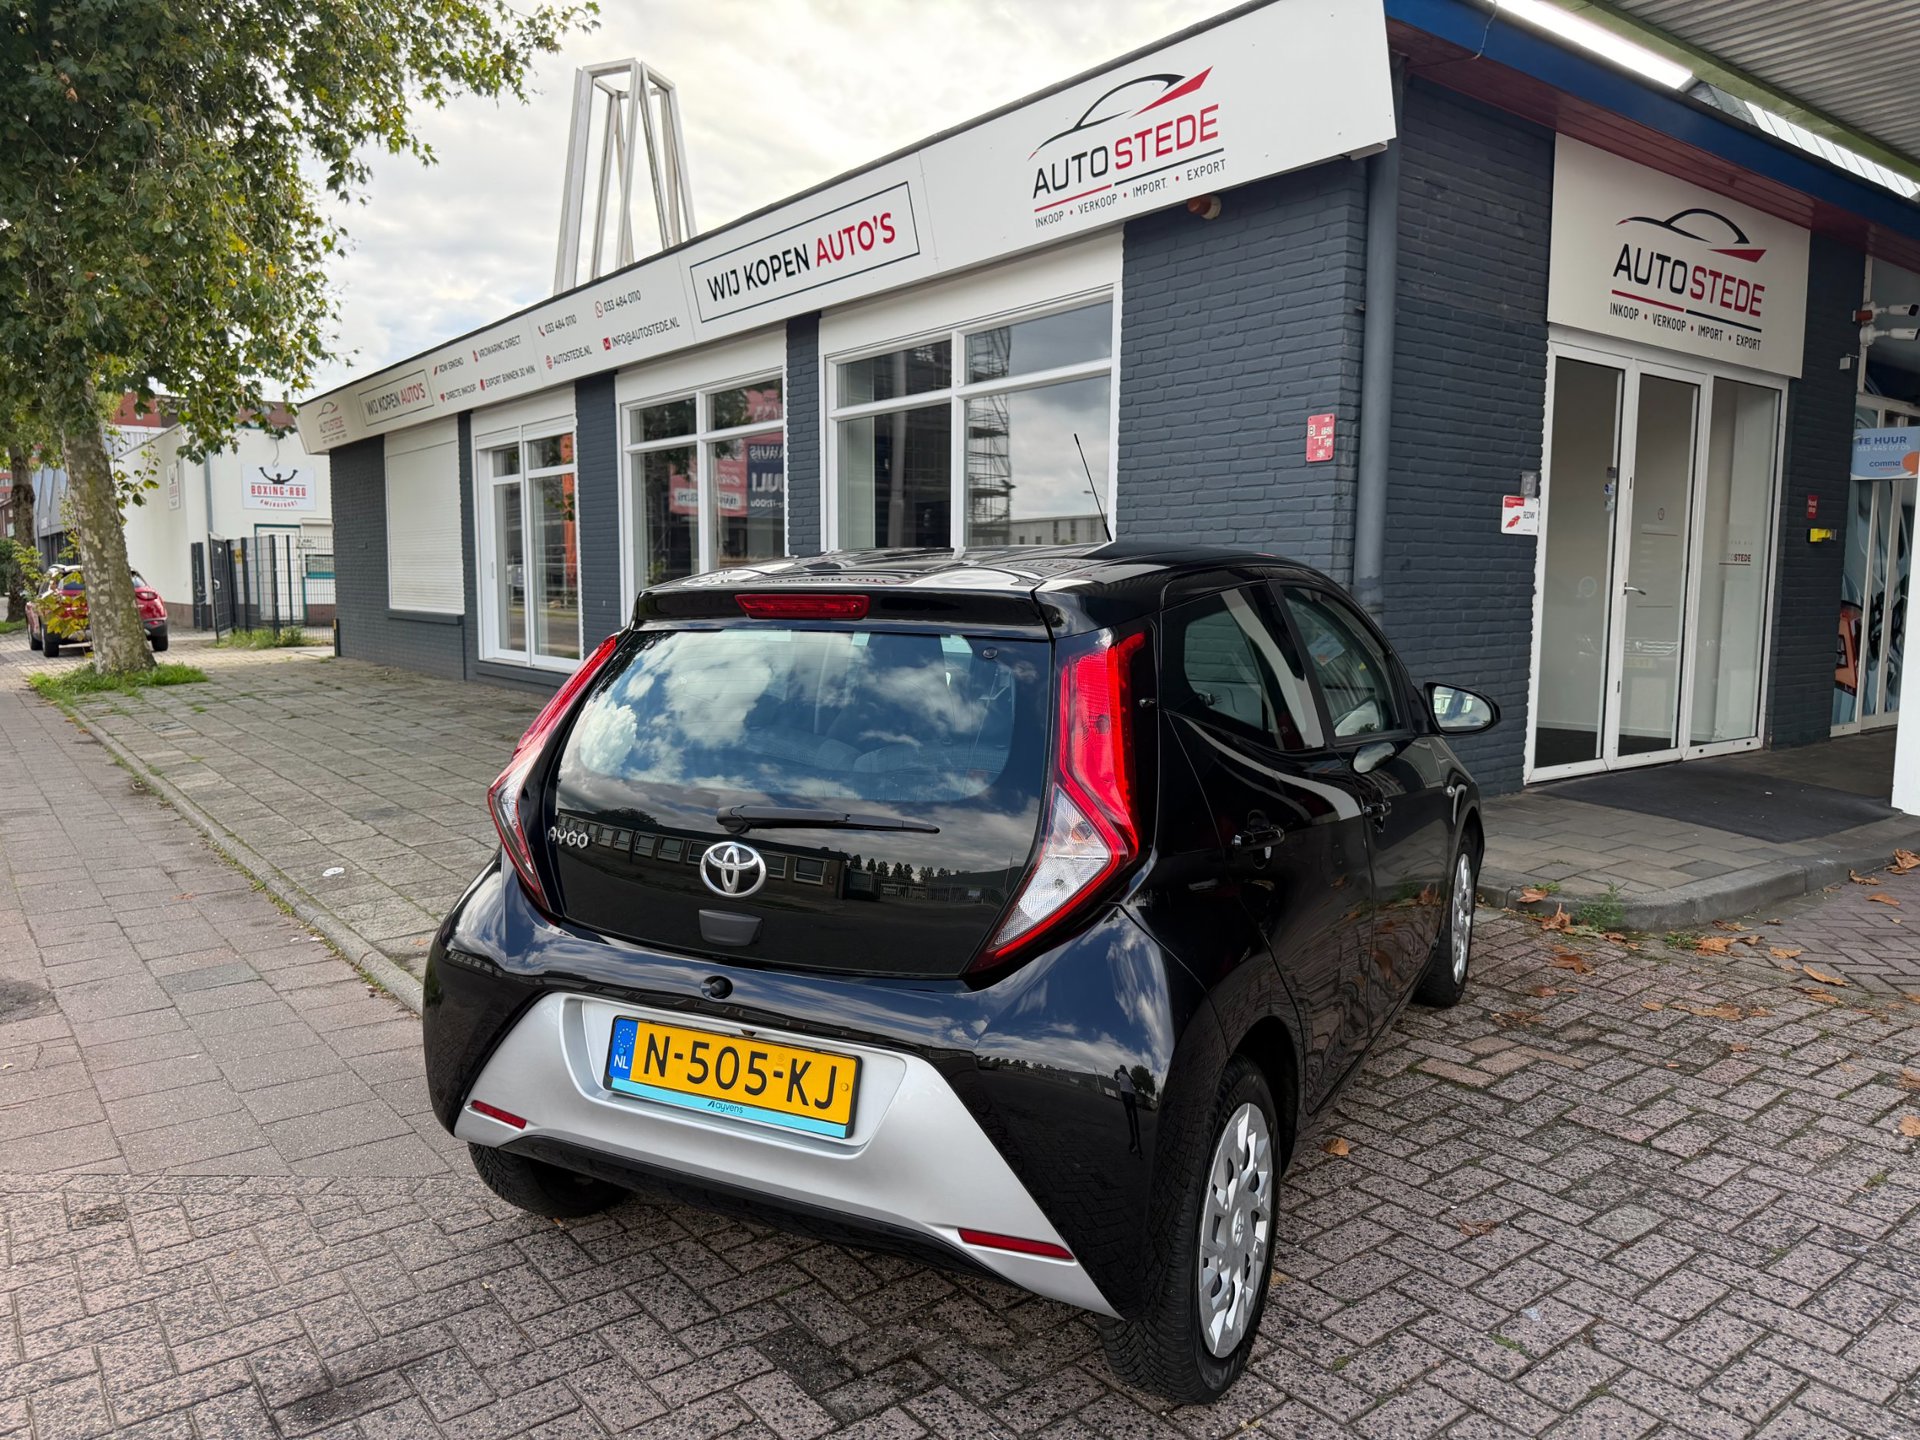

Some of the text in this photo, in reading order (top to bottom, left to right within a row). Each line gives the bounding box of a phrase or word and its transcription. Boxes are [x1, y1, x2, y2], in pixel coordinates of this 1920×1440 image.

[1035, 159, 1226, 228] INKOOP VERKOOP IMPORT EXPORT
[707, 212, 896, 302] WIJ KOPEN AUTO'S
[604, 290, 641, 312] 033 484 0110
[544, 322, 554, 334] 033
[555, 319, 566, 330] 484
[611, 317, 680, 347] INFO@AUTOSTEDE.NL
[1610, 302, 1762, 351] INKOOP VERKOOP IMPORT EXPORT
[553, 345, 592, 365] AUTOSTEDE.NL
[485, 374, 501, 388] EXPORT
[365, 383, 426, 416] WIJ KOPEN AUTO'S
[1858, 435, 1907, 446] TE HUUR
[547, 826, 589, 849] AYGO
[613, 1054, 629, 1070] NL
[643, 1033, 837, 1110] N-505-KJ
[715, 1102, 744, 1113] ayvens
